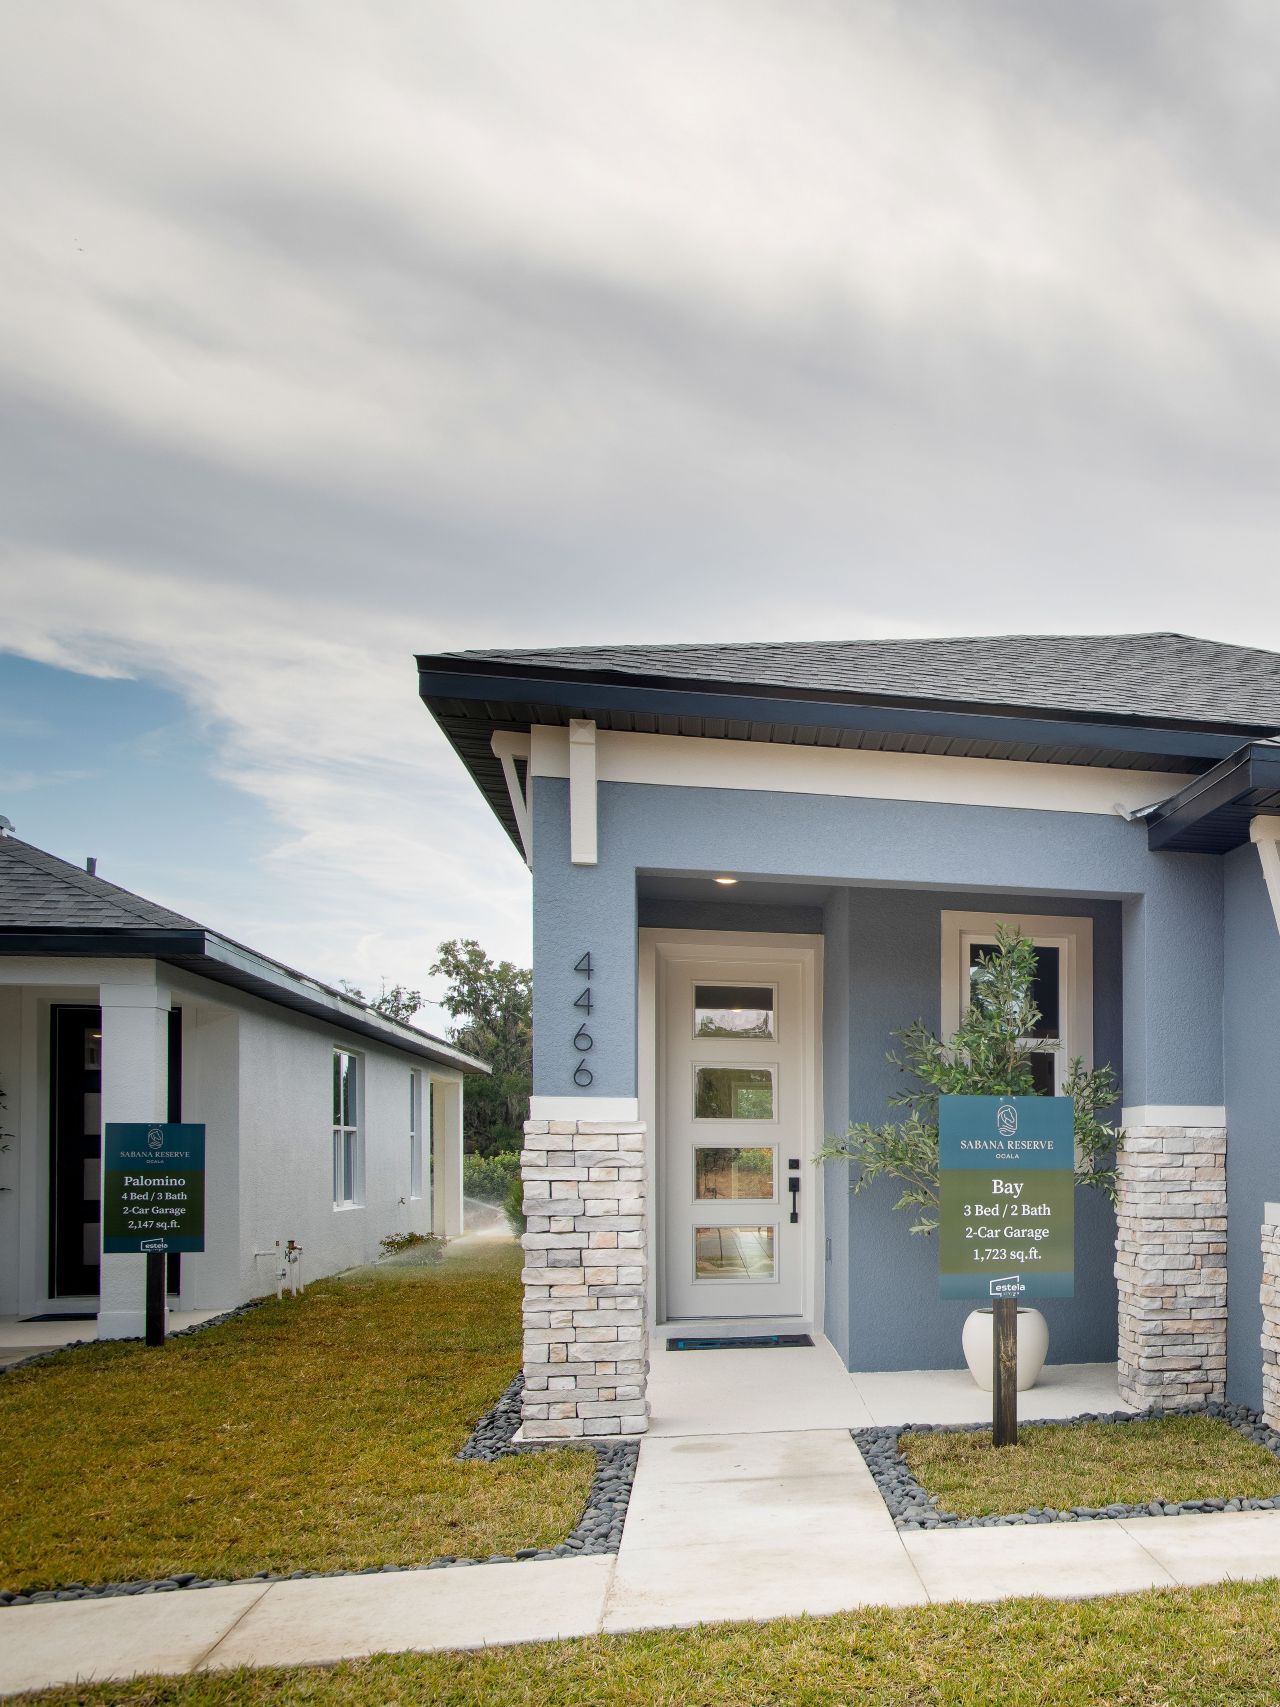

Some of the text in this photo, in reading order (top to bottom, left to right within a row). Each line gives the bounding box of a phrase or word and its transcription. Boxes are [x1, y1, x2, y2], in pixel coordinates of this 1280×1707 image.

[573, 951, 594, 1088] 4466
[960, 1140, 1054, 1150] SABANA RESERVE
[123, 1176, 186, 1187] Palomino
[991, 1179, 1024, 1198] Bay
[121, 1192, 128, 1201] 4
[130, 1192, 149, 1201] Bed
[157, 1192, 163, 1201] 3
[165, 1192, 188, 1201] Bath
[122, 1206, 187, 1216] 2-Car Garage
[963, 1204, 971, 1217] 3
[974, 1204, 999, 1217] Bed
[1010, 1204, 1018, 1217] 2
[1021, 1204, 1051, 1217] Bath
[128, 1219, 181, 1231] 2,147 sq.ft.
[965, 1226, 1050, 1241] 2-Car Garage
[973, 1247, 1042, 1263] 1,723 sq.ft.
